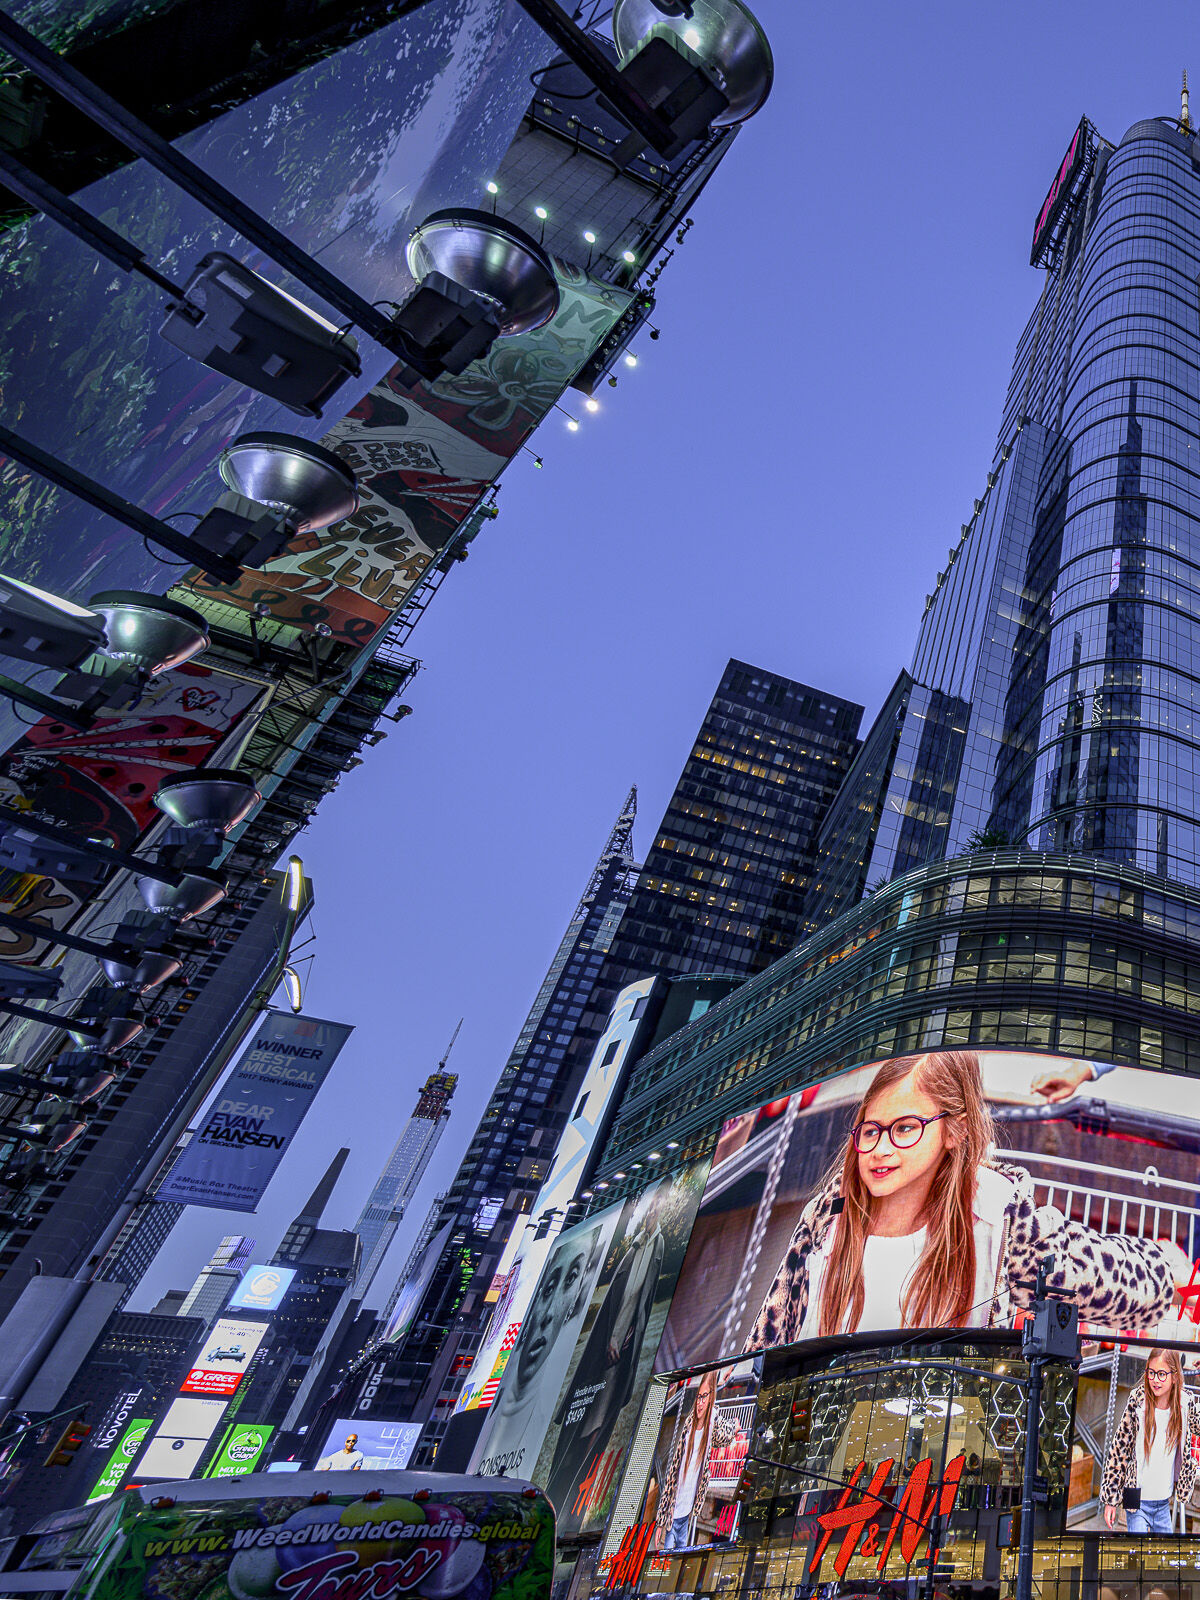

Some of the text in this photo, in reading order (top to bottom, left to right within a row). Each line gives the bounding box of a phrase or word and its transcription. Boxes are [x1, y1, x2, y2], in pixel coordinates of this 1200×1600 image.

[248, 1050, 297, 1067] BEST
[257, 1039, 323, 1060] WINNER
[237, 1072, 314, 1090] 2017 TONY AWARD
[242, 1061, 317, 1083] MUSICAL
[215, 1100, 274, 1120] DEAR
[209, 1112, 264, 1132] EVAN
[201, 1125, 287, 1149] HANSEN
[170, 1183, 255, 1200] DearEvanHansen.com
[227, 1182, 259, 1193] Theatre
[203, 1373, 239, 1383] GREE
[359, 1362, 386, 1411] 1500
[98, 1388, 142, 1448] NOVOTEL
[477, 1448, 526, 1477] CONSCIOUS
[809, 1455, 966, 1577] H&M
[143, 1519, 542, 1557] www.WeedWorldCandies.global
[605, 1520, 657, 1590] H&M
[276, 1548, 443, 1600] Tours
